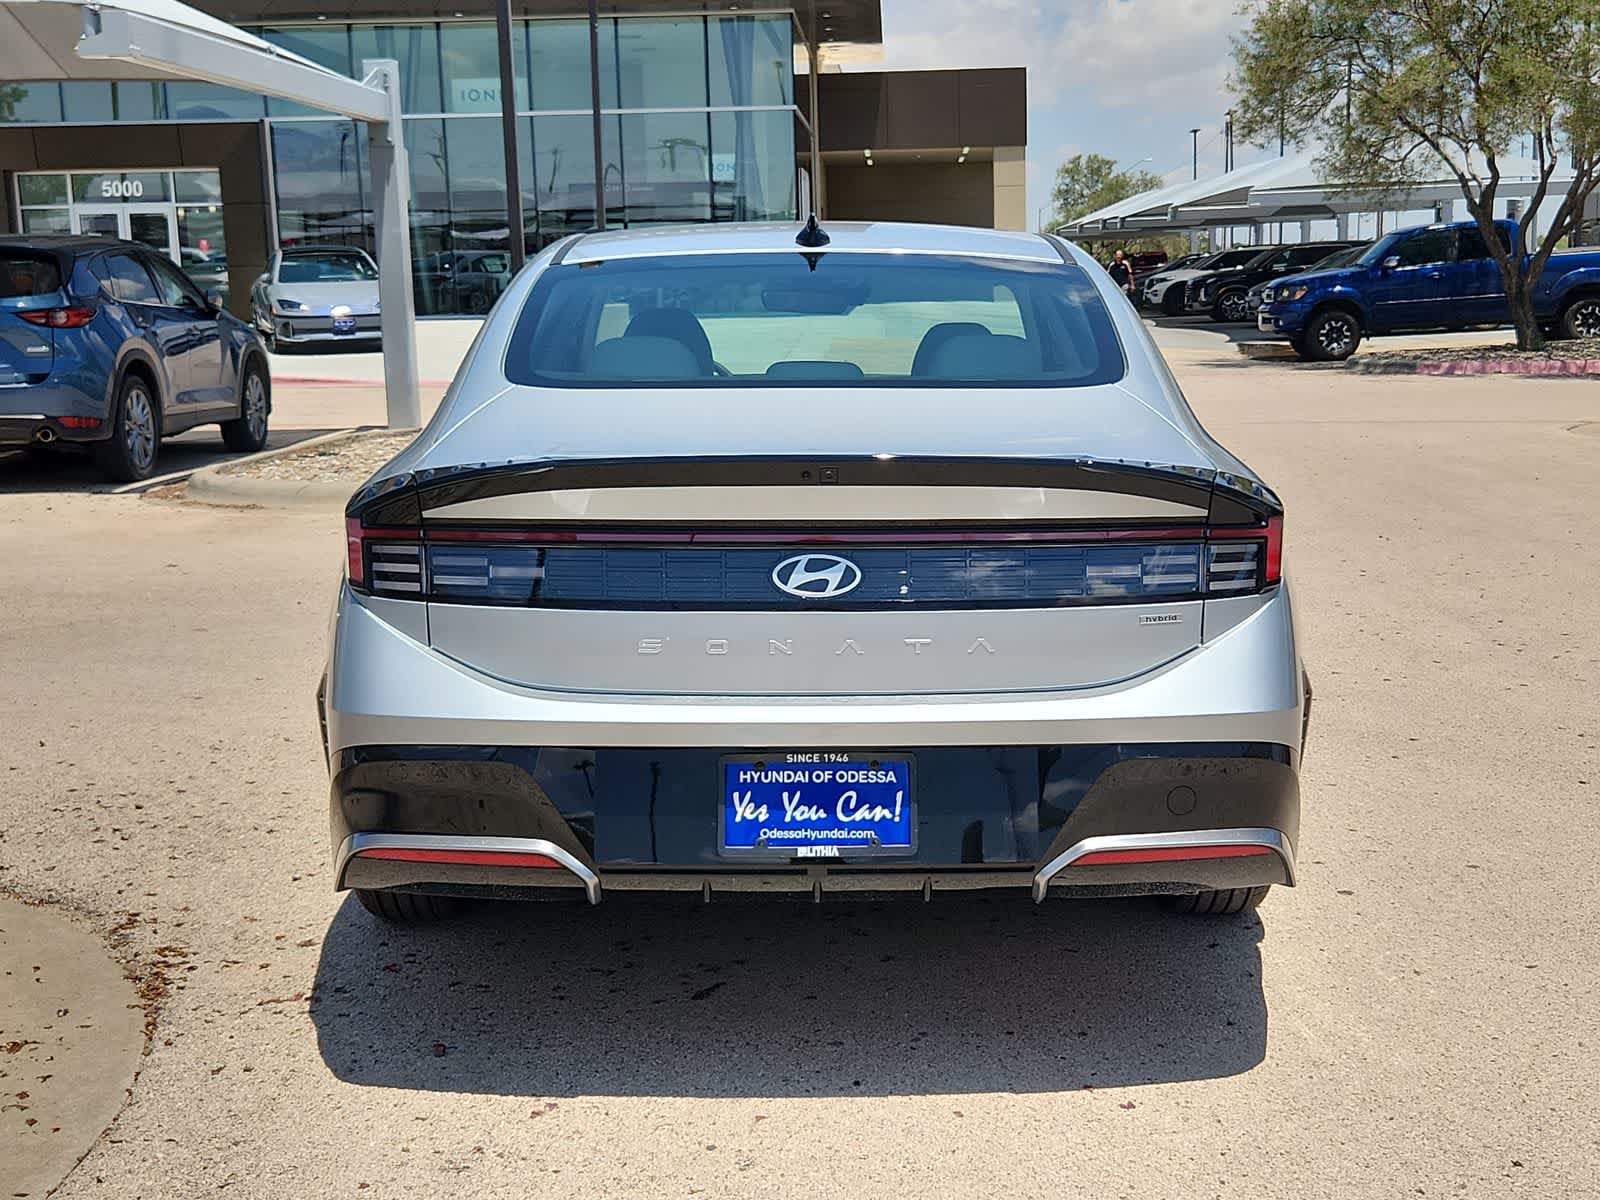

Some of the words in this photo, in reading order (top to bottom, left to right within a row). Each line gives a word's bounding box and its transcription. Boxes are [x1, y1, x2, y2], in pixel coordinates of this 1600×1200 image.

[461, 88, 496, 102] ION
[101, 180, 143, 197] 5000
[1145, 614, 1177, 624] hybrid
[637, 638, 995, 655] SONATA
[786, 753, 820, 763] SINCE
[823, 753, 849, 763] 1946
[739, 770, 809, 783] HYUNDAI
[811, 770, 833, 783] OF
[835, 770, 897, 783] ODESSA
[732, 790, 770, 823] Yes
[782, 790, 828, 823] You
[836, 790, 904, 823] Can!
[759, 828, 876, 841] OdessaHyundai.com
[807, 845, 840, 857] LITHIA
